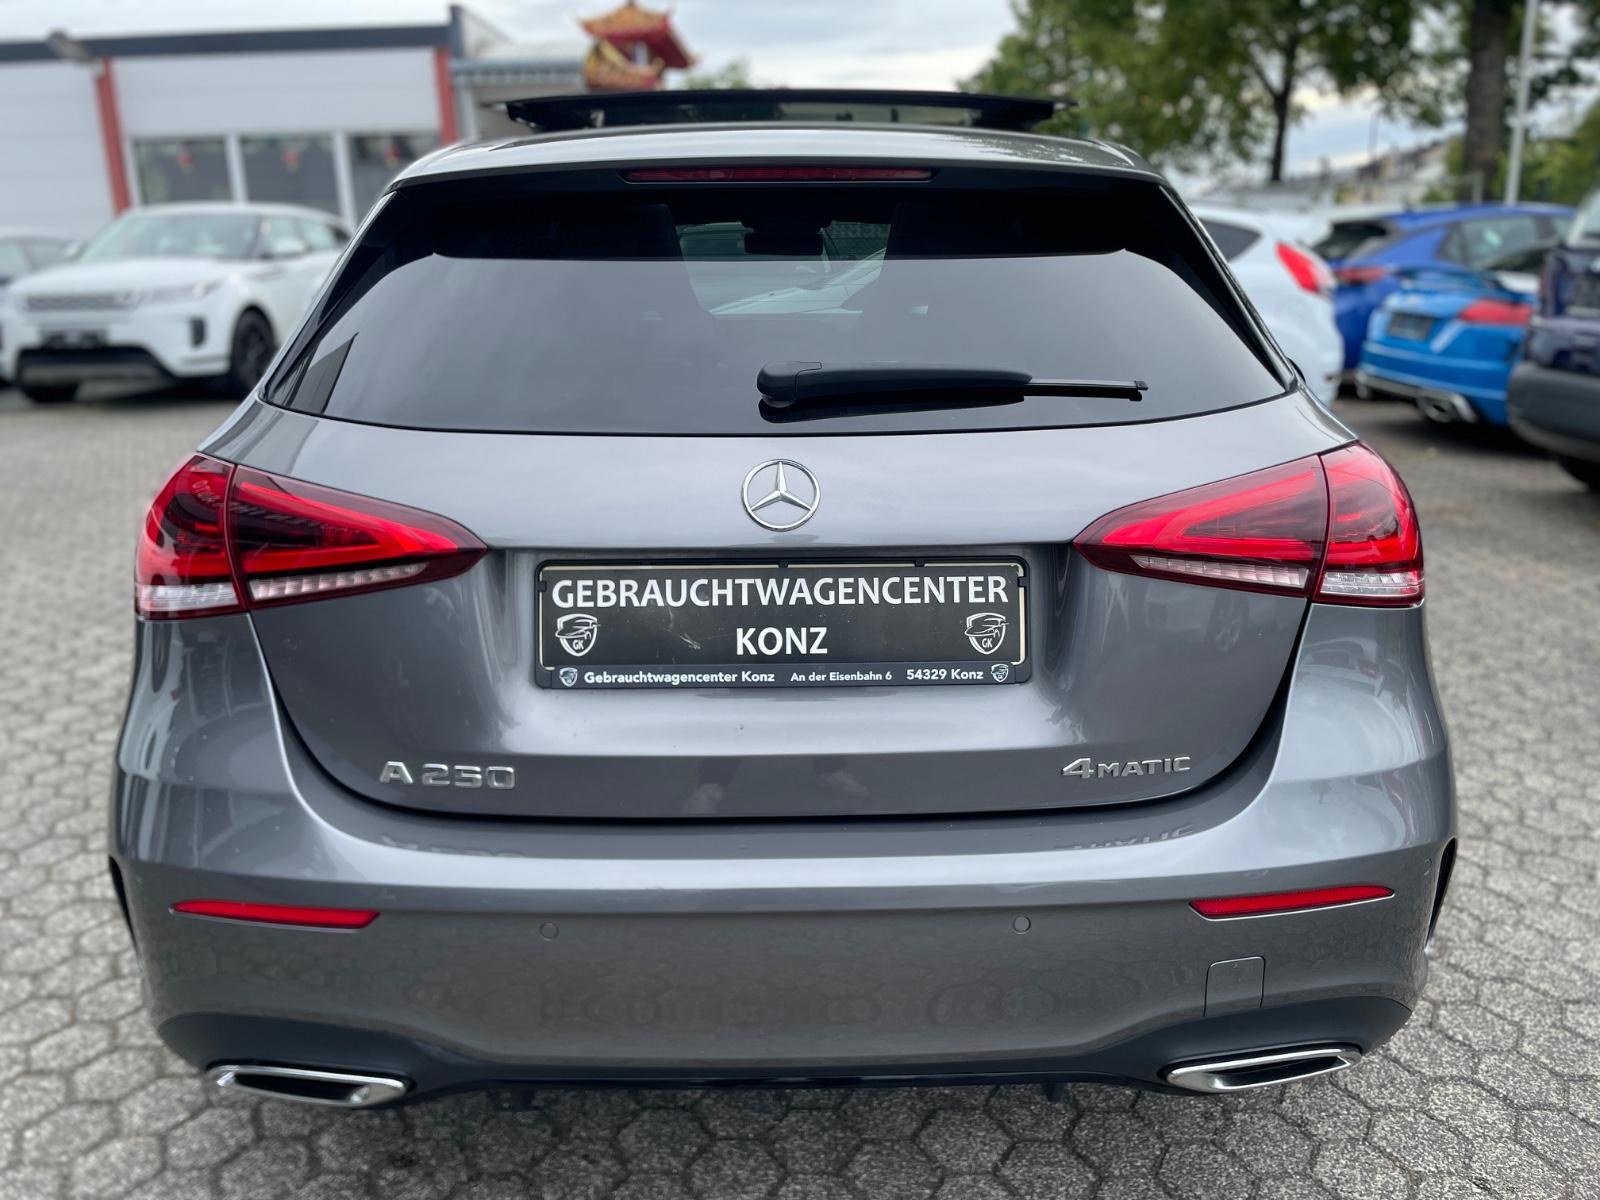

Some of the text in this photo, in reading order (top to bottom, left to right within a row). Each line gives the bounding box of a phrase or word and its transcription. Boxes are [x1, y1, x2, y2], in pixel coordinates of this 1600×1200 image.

[552, 576, 1009, 608] GEBRAUCHTWAGENCENTER
[572, 639, 584, 650] GK
[736, 627, 828, 656] KONZ
[981, 638, 993, 648] GK
[584, 671, 738, 686] Gebrauchtwagencenter
[741, 670, 775, 683] Konz
[790, 672, 806, 682] An
[808, 671, 826, 682] der
[829, 671, 882, 682] Eisenbahn
[885, 671, 893, 681] 6
[906, 669, 947, 681] 54329
[951, 668, 984, 680] Konz
[379, 761, 516, 790] A 250
[1062, 755, 1192, 779] 4MATIC
